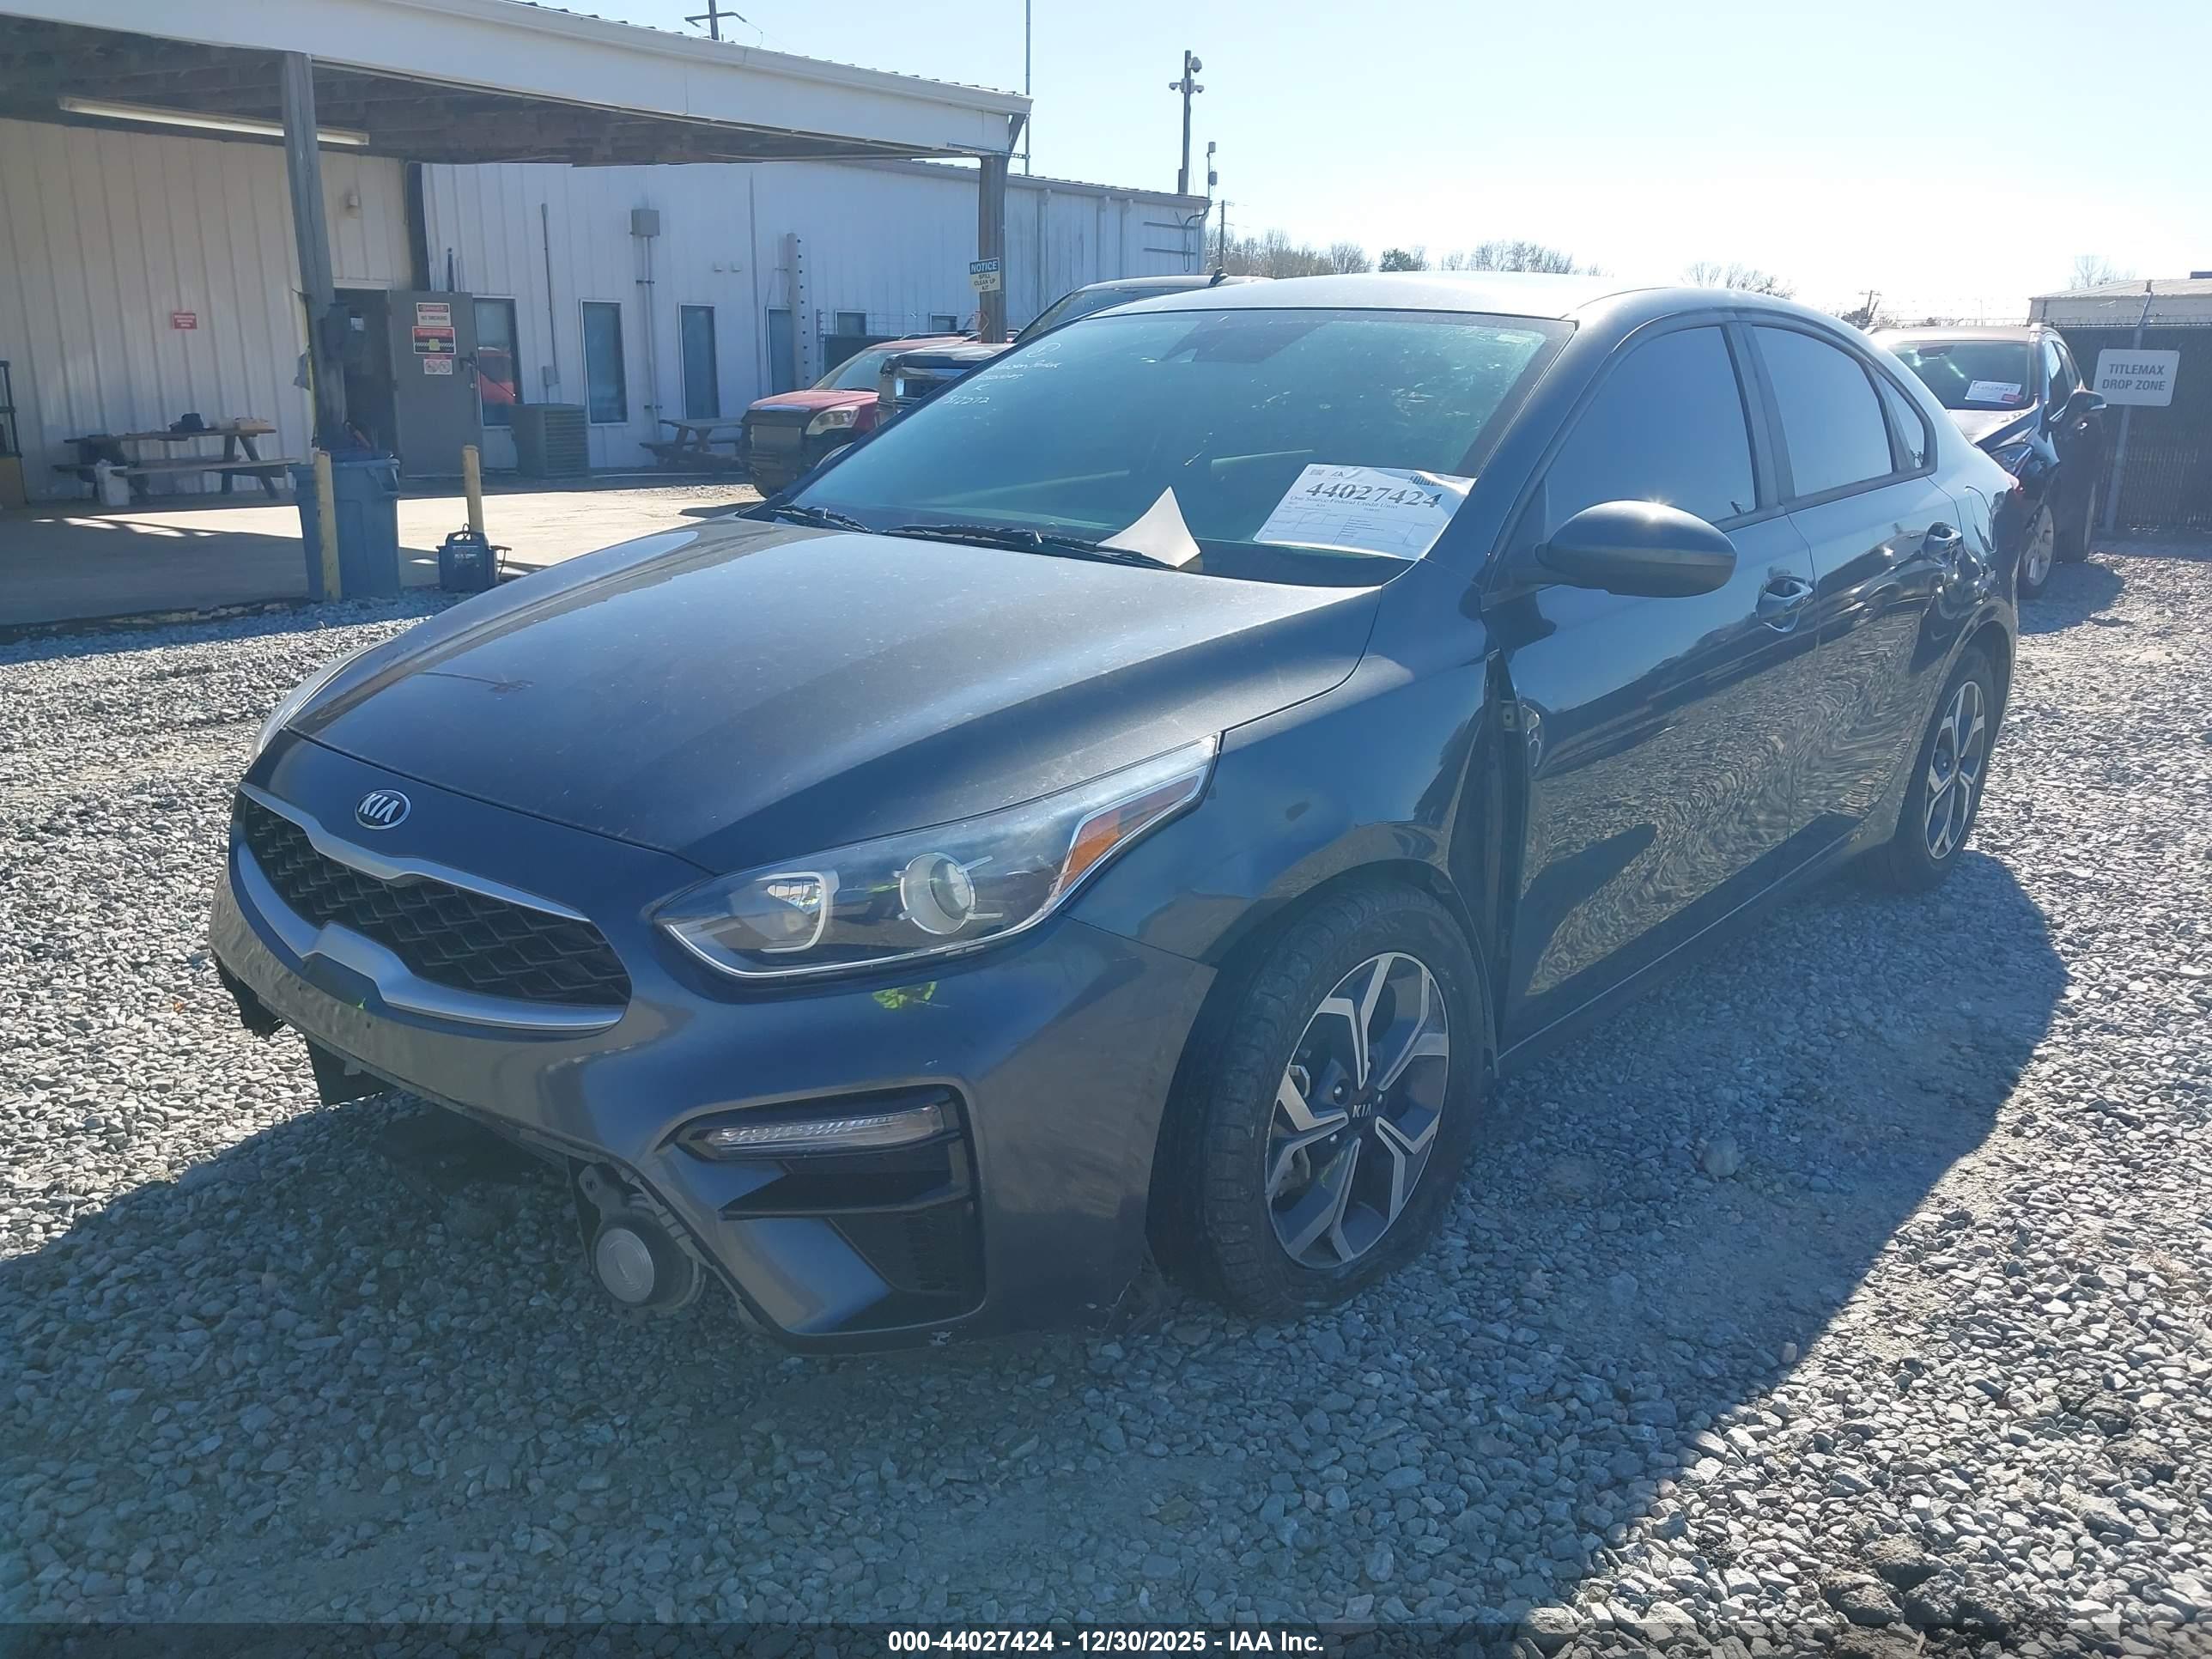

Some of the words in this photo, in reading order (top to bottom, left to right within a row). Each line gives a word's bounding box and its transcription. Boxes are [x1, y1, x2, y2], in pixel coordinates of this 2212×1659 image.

[970, 260, 998, 273] NOTICE
[2108, 363, 2165, 375] TITLEMAX
[2101, 379, 2133, 390] DROP
[2135, 380, 2166, 392] ZONE
[1305, 482, 1443, 508] 44027424
[357, 793, 400, 823] KIA
[1352, 1103, 1371, 1118] KIA
